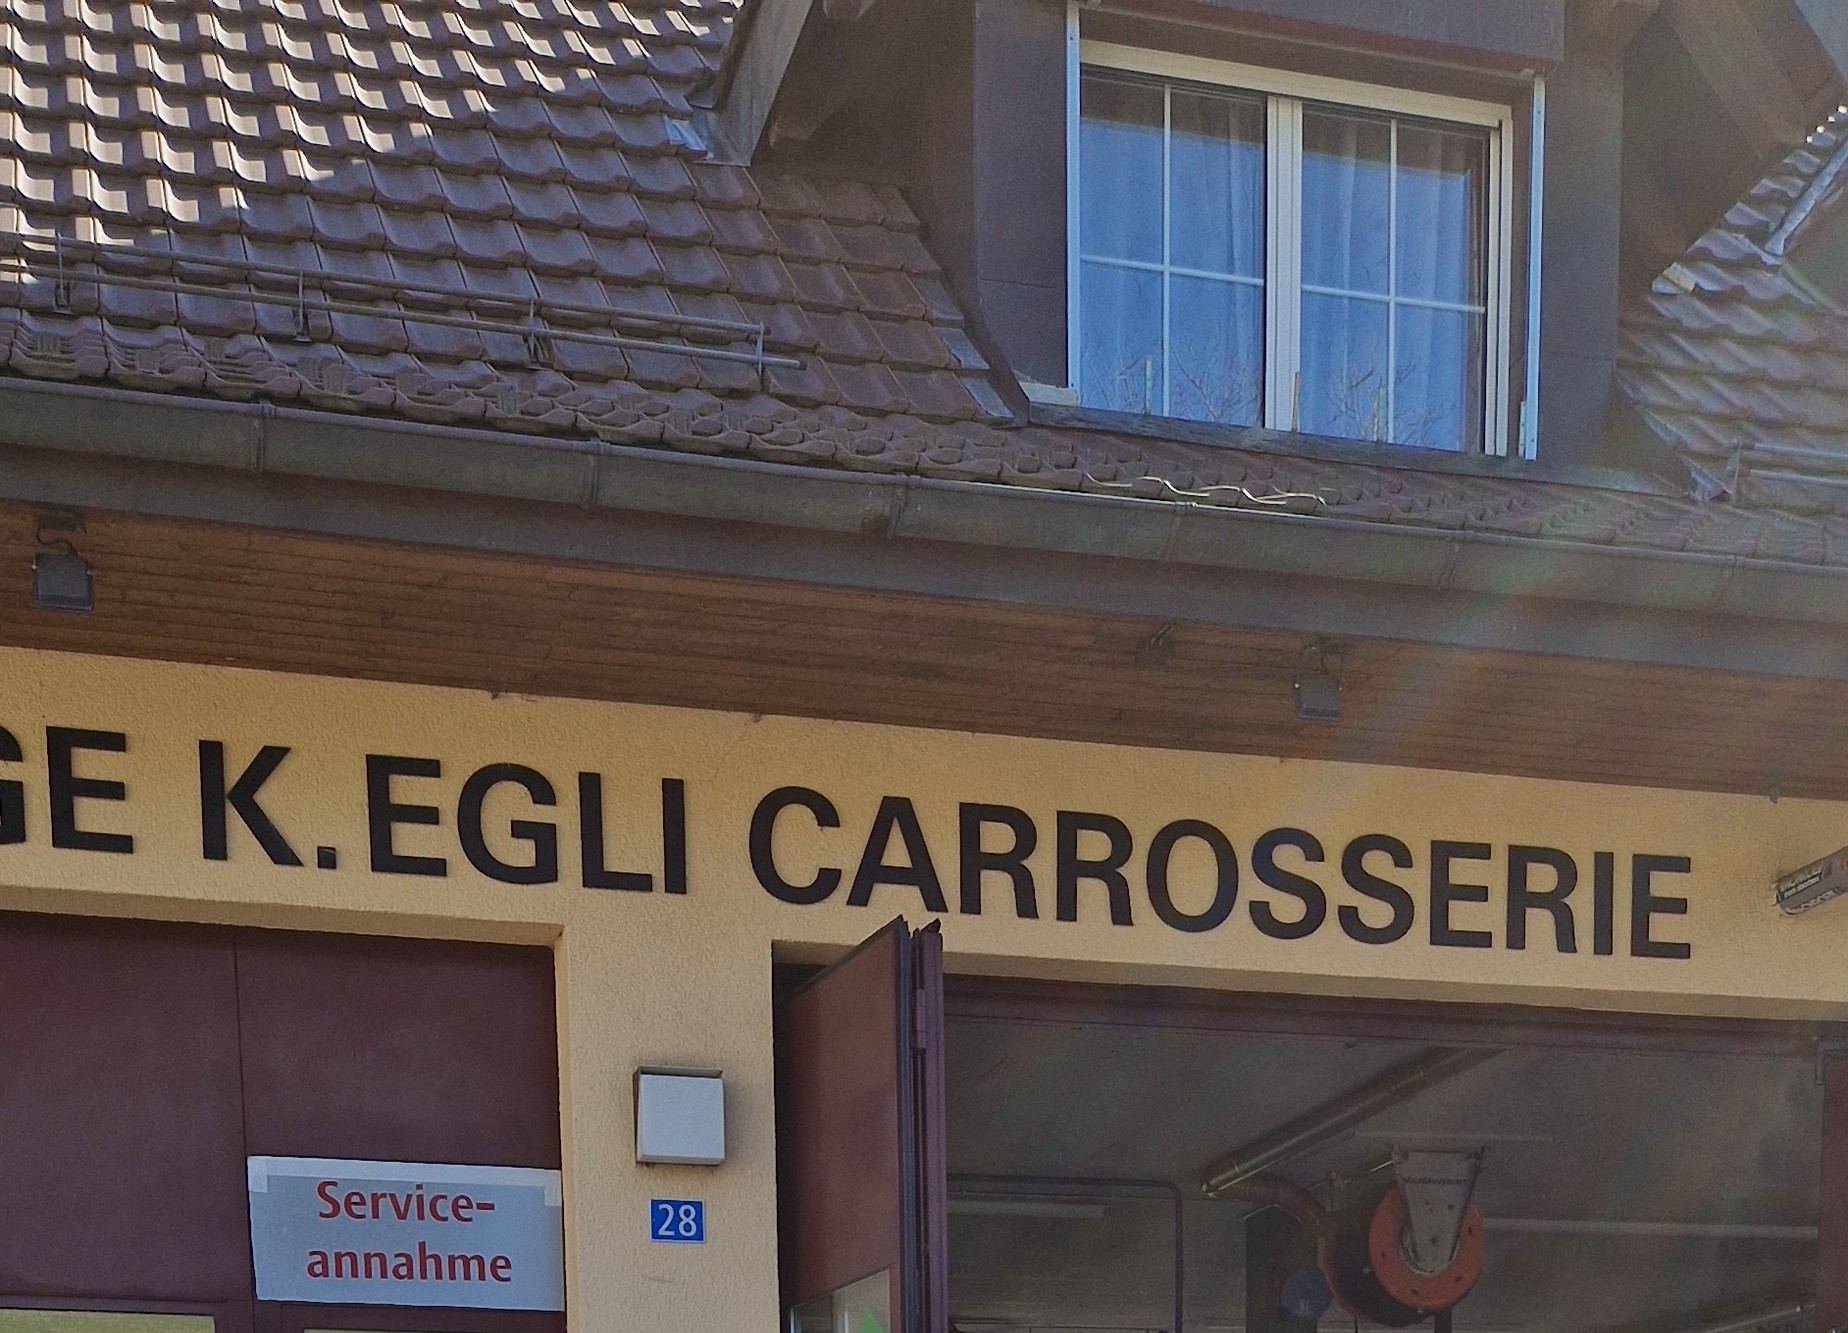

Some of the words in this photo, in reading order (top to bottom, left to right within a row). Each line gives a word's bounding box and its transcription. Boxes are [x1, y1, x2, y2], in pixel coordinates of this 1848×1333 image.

[0, 724, 133, 854] E
[748, 785, 1692, 961] CARROSSERIE
[316, 1180, 496, 1224] Service-
[656, 1203, 697, 1237] 28
[306, 1241, 512, 1283] annahme
